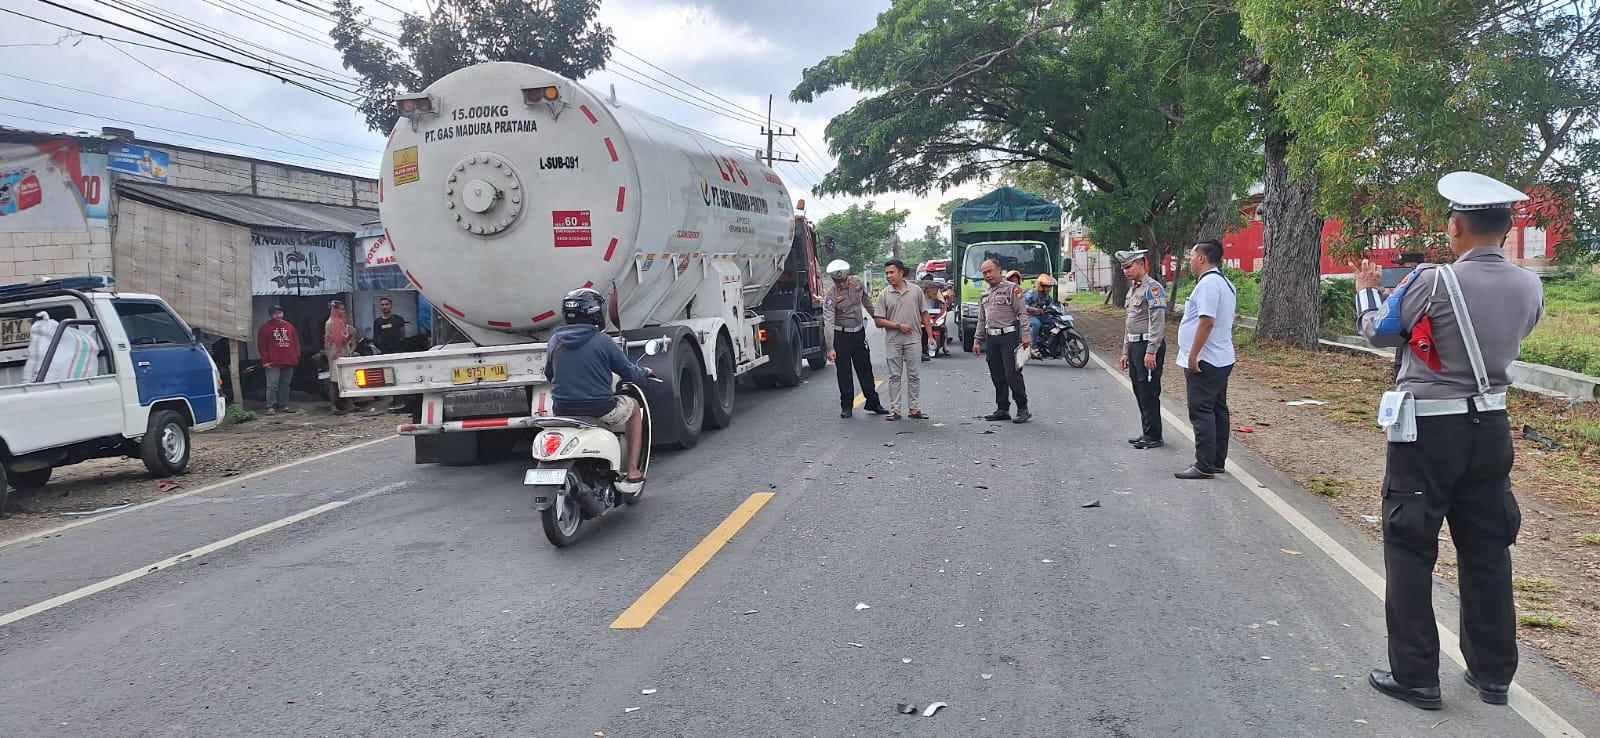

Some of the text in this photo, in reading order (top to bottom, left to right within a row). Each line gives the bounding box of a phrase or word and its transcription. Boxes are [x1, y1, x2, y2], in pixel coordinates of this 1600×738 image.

[451, 105, 509, 121] 15.000KG
[424, 120, 538, 143] PT. GAS MADURA PRATAMA
[539, 156, 580, 170] L-SUB-091
[709, 151, 749, 186] LPG
[564, 216, 578, 226] 60
[466, 366, 486, 378] 9757
